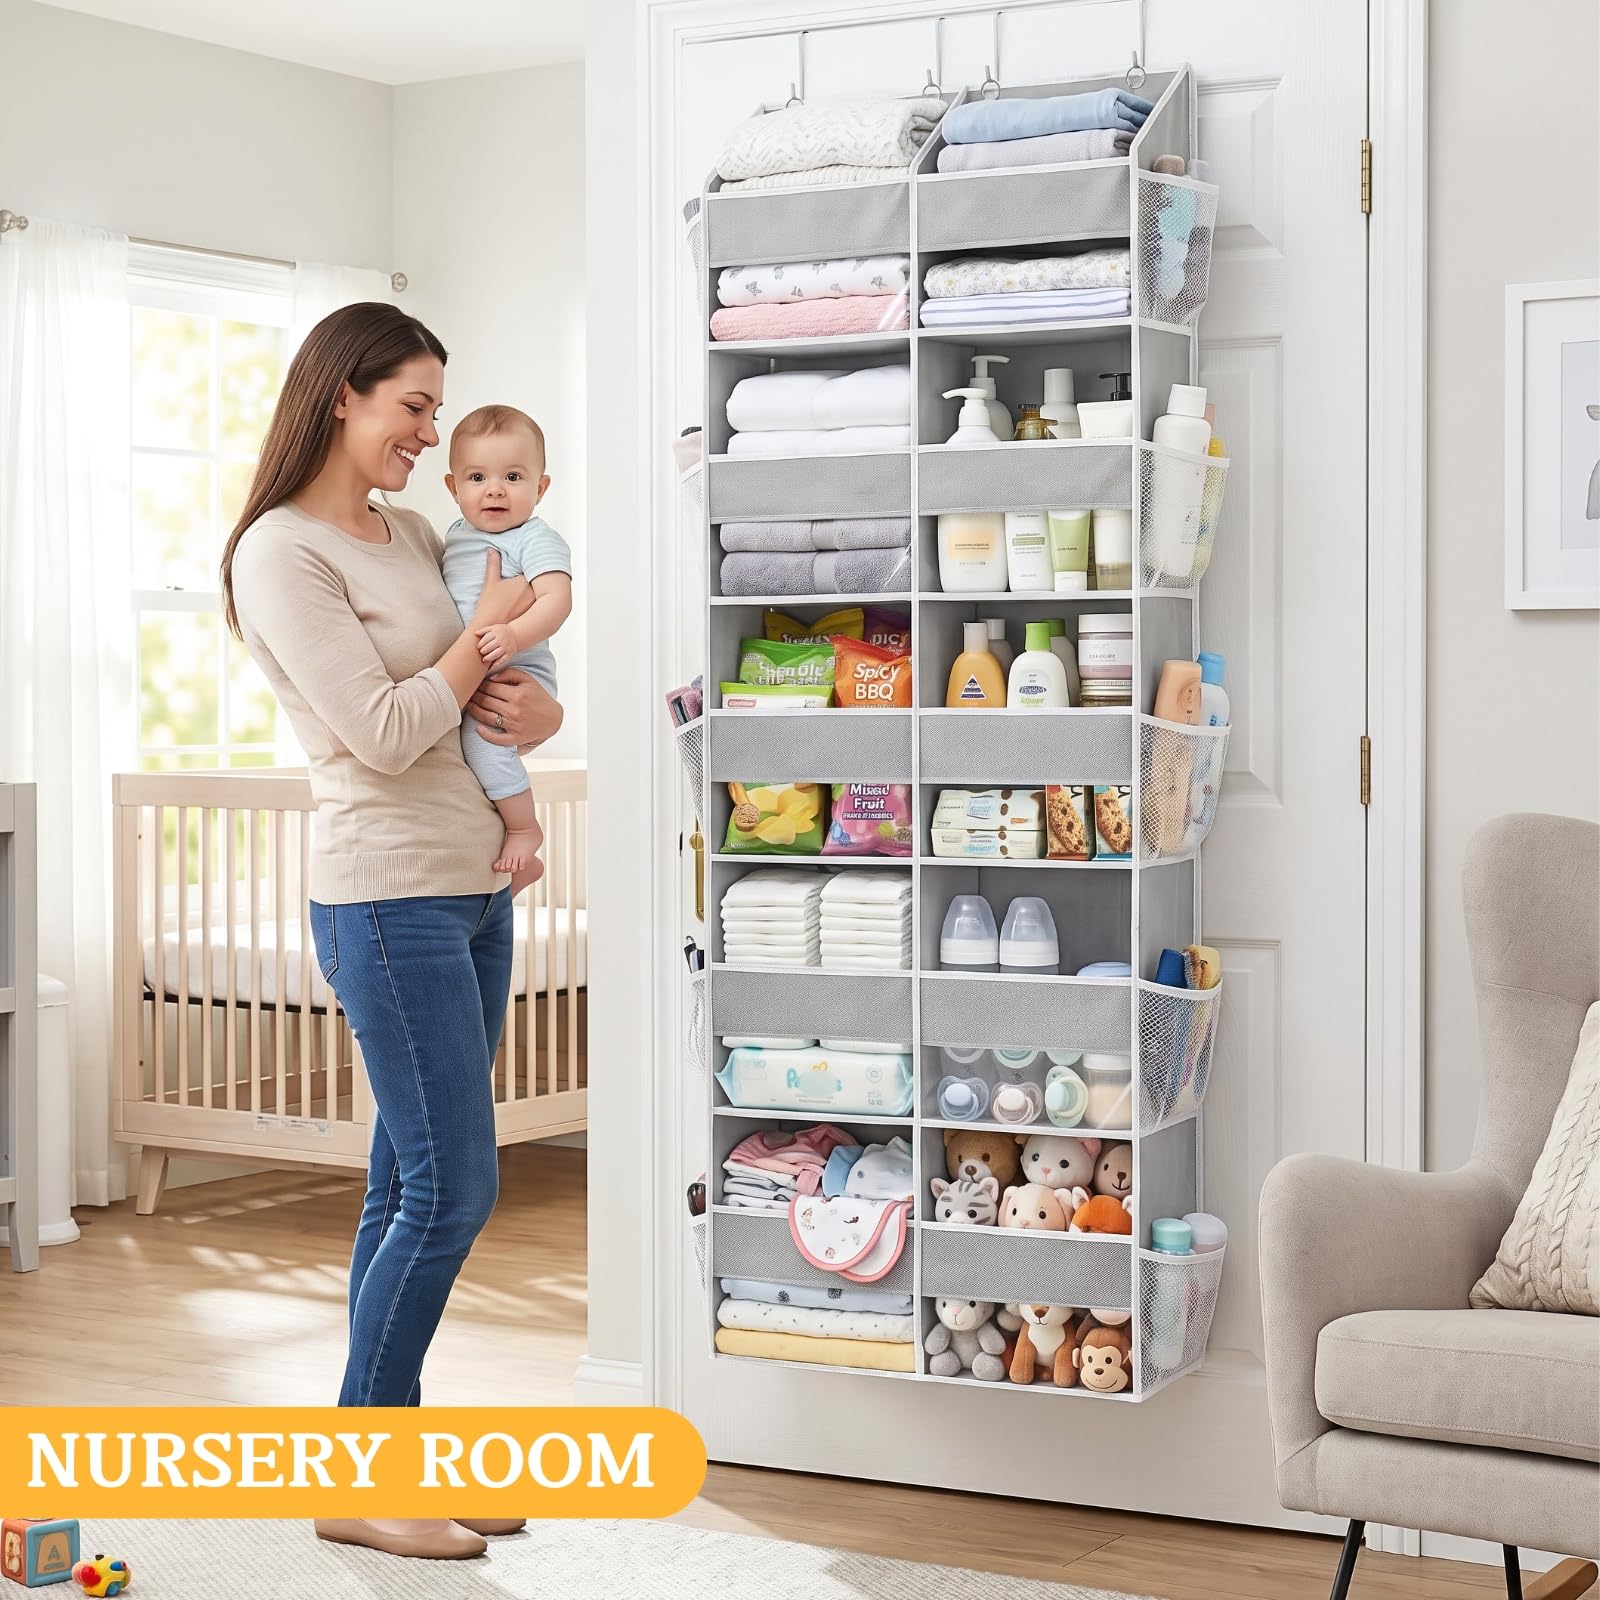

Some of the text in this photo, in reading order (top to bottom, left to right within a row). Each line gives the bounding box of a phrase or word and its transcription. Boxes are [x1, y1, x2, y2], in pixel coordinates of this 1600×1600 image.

[853, 663, 901, 681] Spicy
[855, 684, 894, 701] BBQ
[854, 798, 886, 810] Fruit
